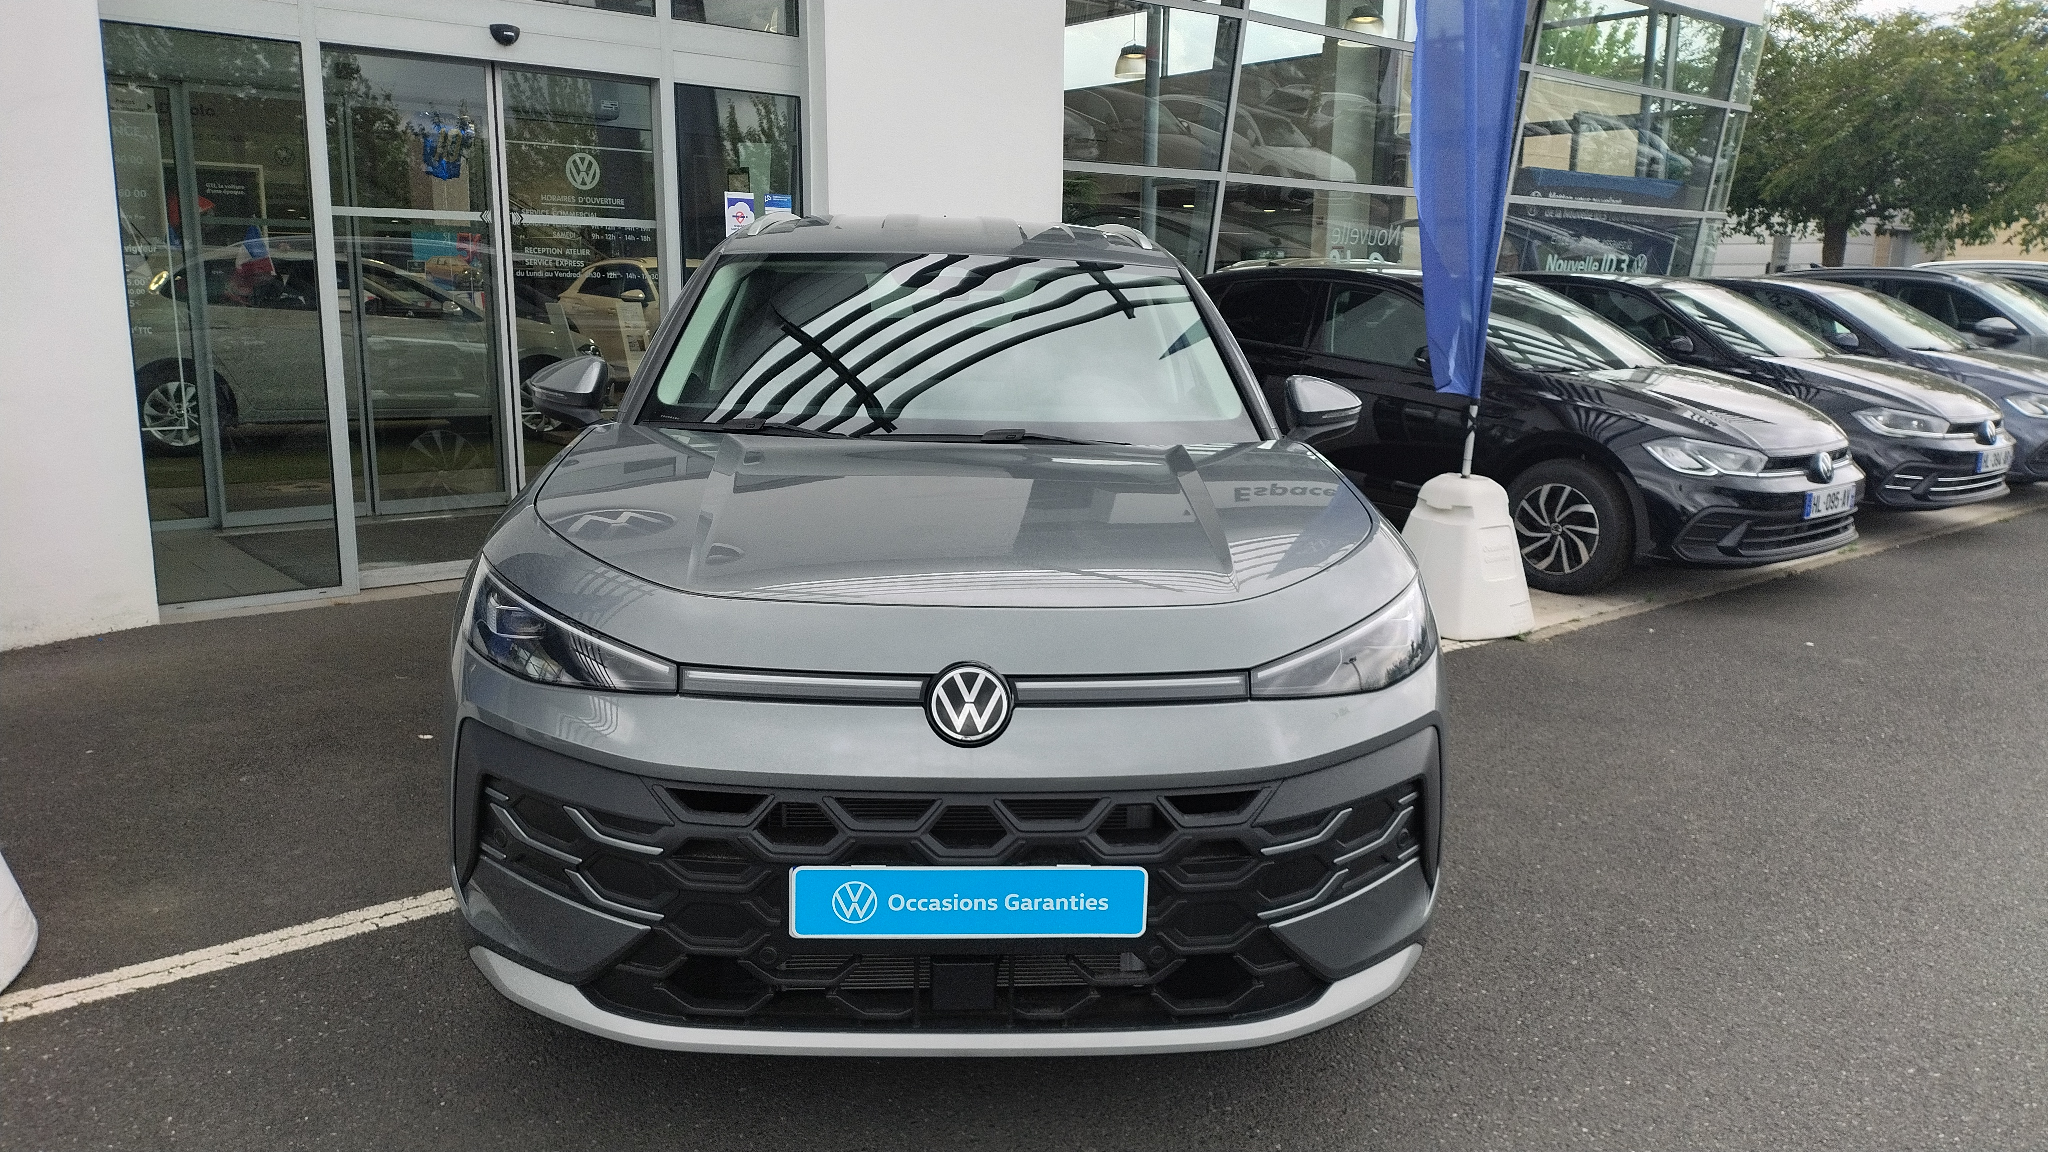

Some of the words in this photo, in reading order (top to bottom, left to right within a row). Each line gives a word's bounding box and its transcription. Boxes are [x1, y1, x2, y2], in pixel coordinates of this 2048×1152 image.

[541, 194, 576, 203] HORAIRES
[578, 196, 625, 205] D'OUVERTURE
[552, 231, 576, 239] SAMEDI
[524, 247, 563, 255] RECEPTION
[565, 248, 591, 256] ATELIER
[525, 259, 553, 267] SERVICE
[555, 259, 585, 267] EXPRESS
[1545, 253, 1600, 272] Nouvelle
[515, 269, 525, 277] du
[526, 269, 544, 277] Lundi
[888, 893, 998, 912] Occasions
[1004, 893, 1109, 912] Garanties
